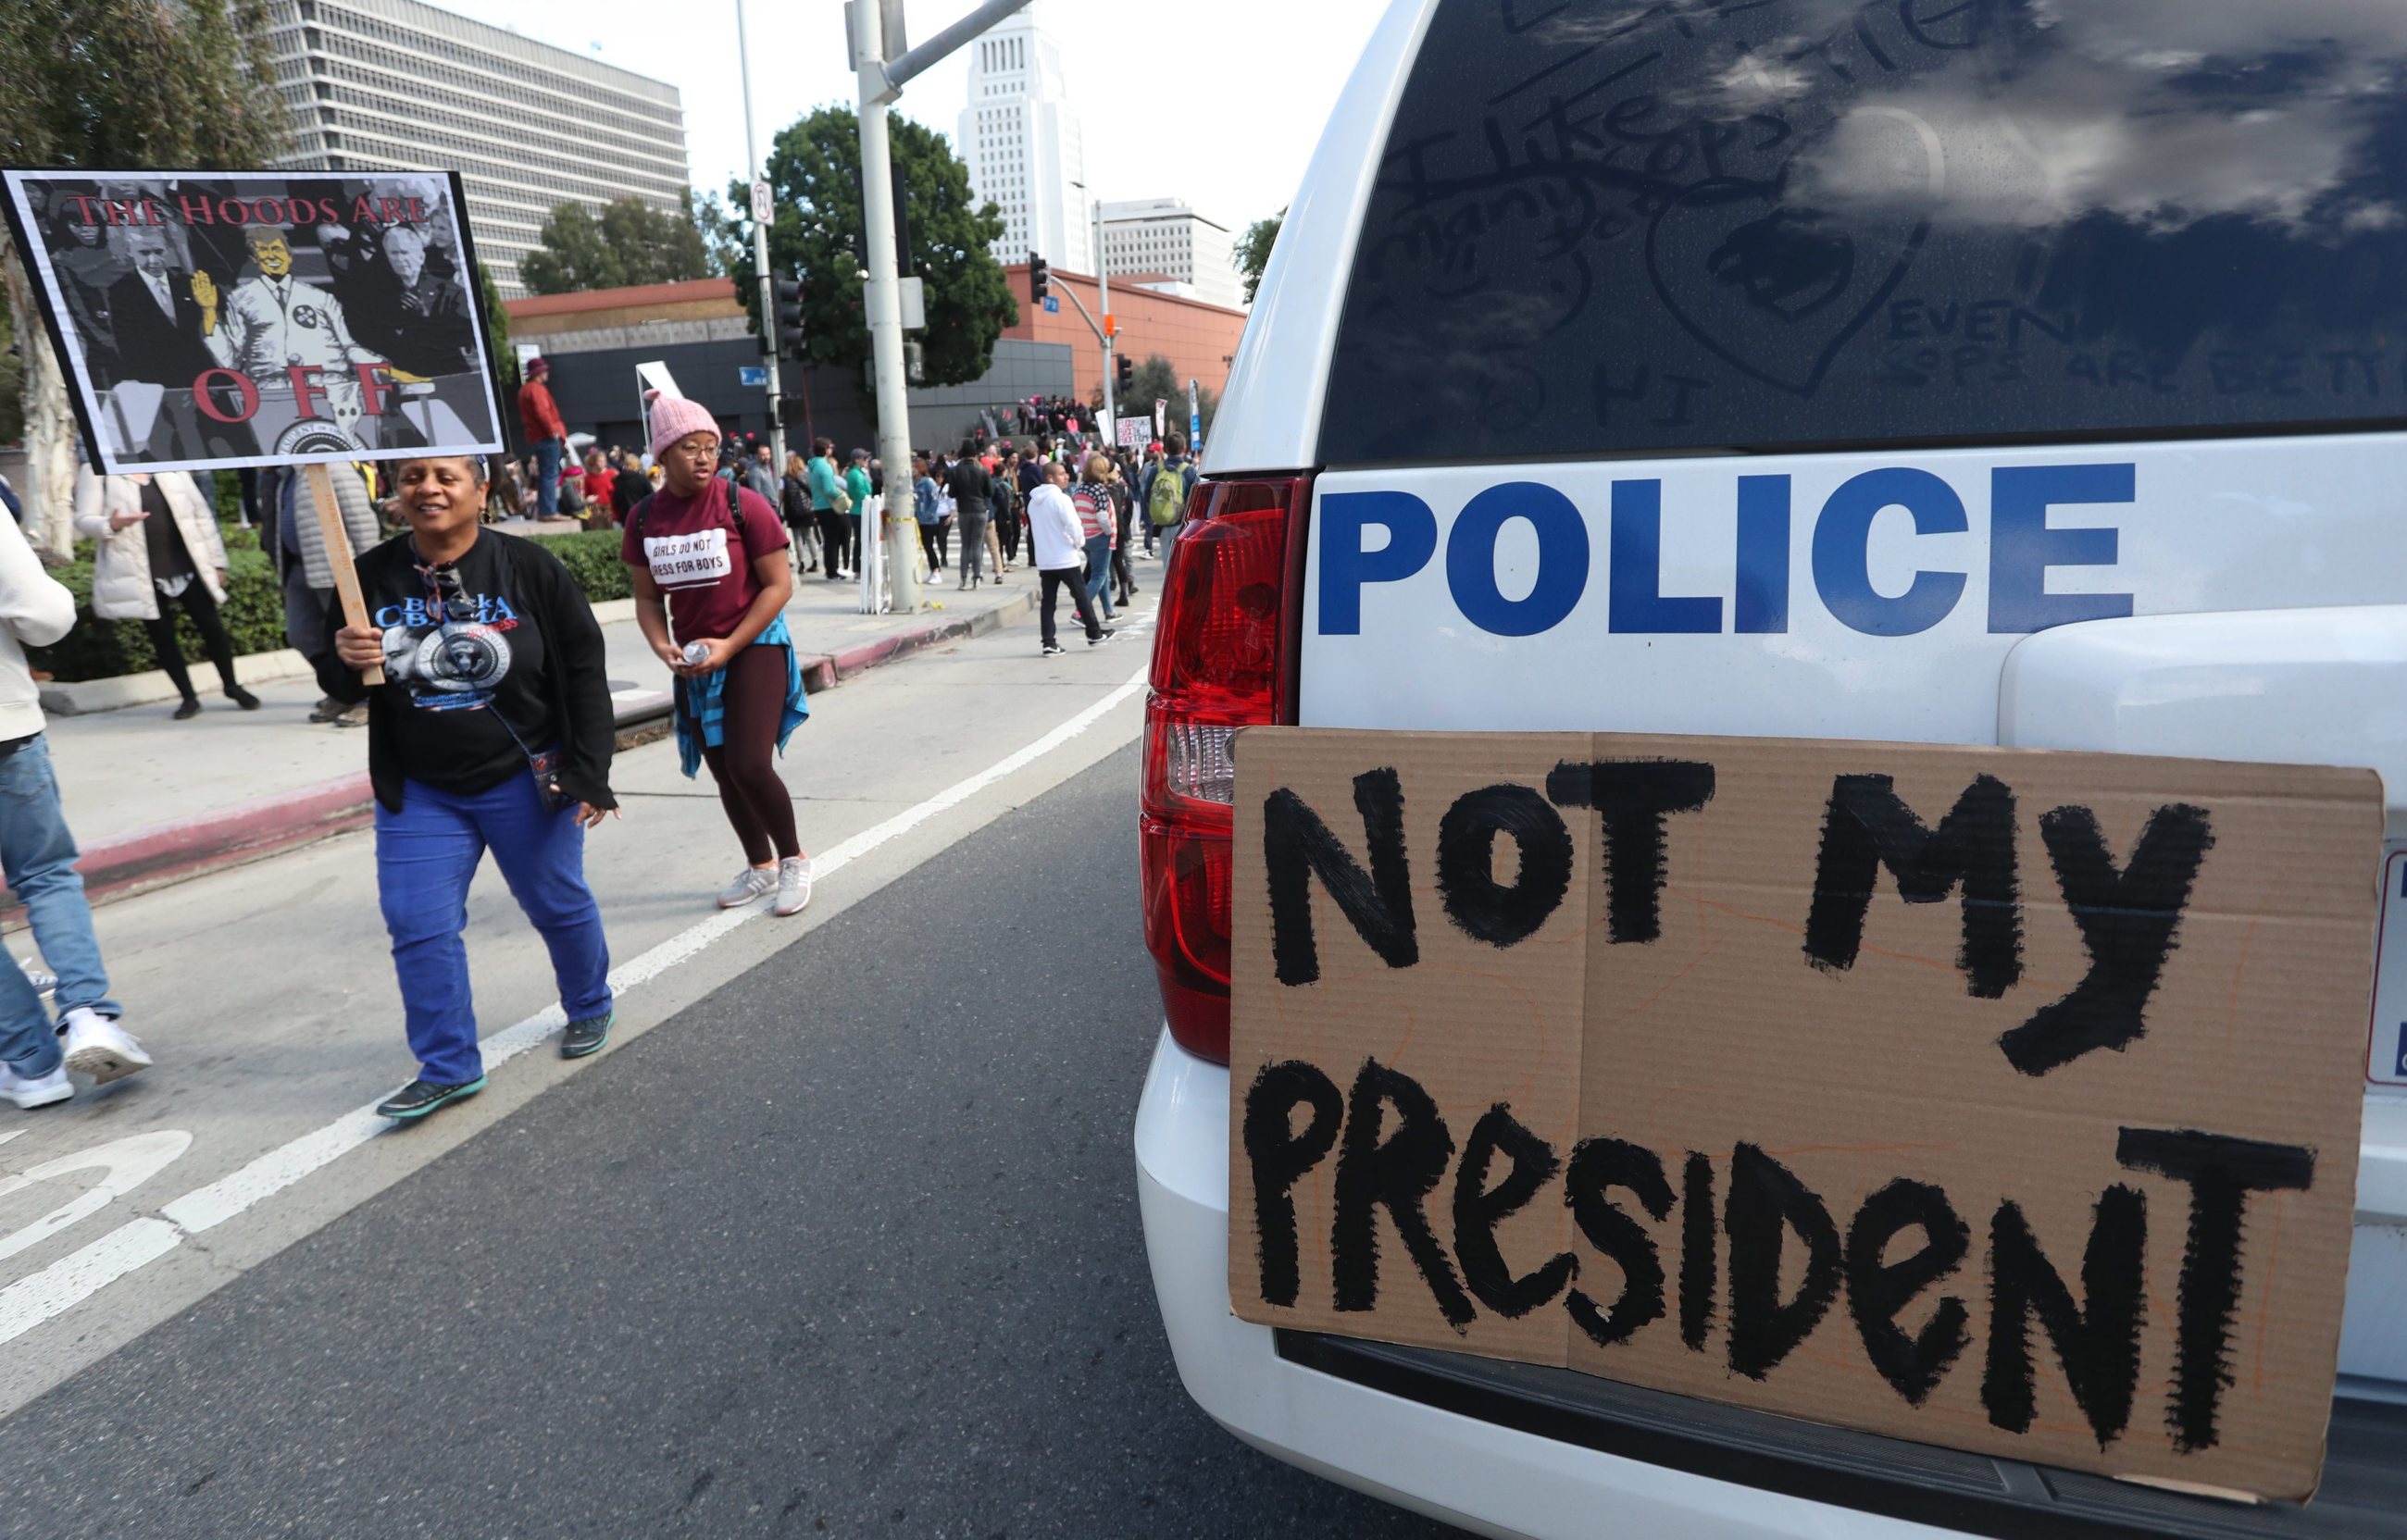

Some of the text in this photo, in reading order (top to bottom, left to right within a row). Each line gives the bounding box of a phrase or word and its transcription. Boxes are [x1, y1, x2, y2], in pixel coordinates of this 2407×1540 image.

[66, 195, 430, 227] THE HOODS ARE
[1889, 298, 2076, 349] EVEN
[2210, 348, 2407, 398] BETT
[653, 539, 711, 557] GIRLS DO NOT
[676, 560, 694, 573] FOR
[696, 556, 723, 571] BOYS
[1318, 463, 2136, 636] POLICE
[375, 596, 518, 628] OBAA
[1262, 755, 1715, 987] NOT
